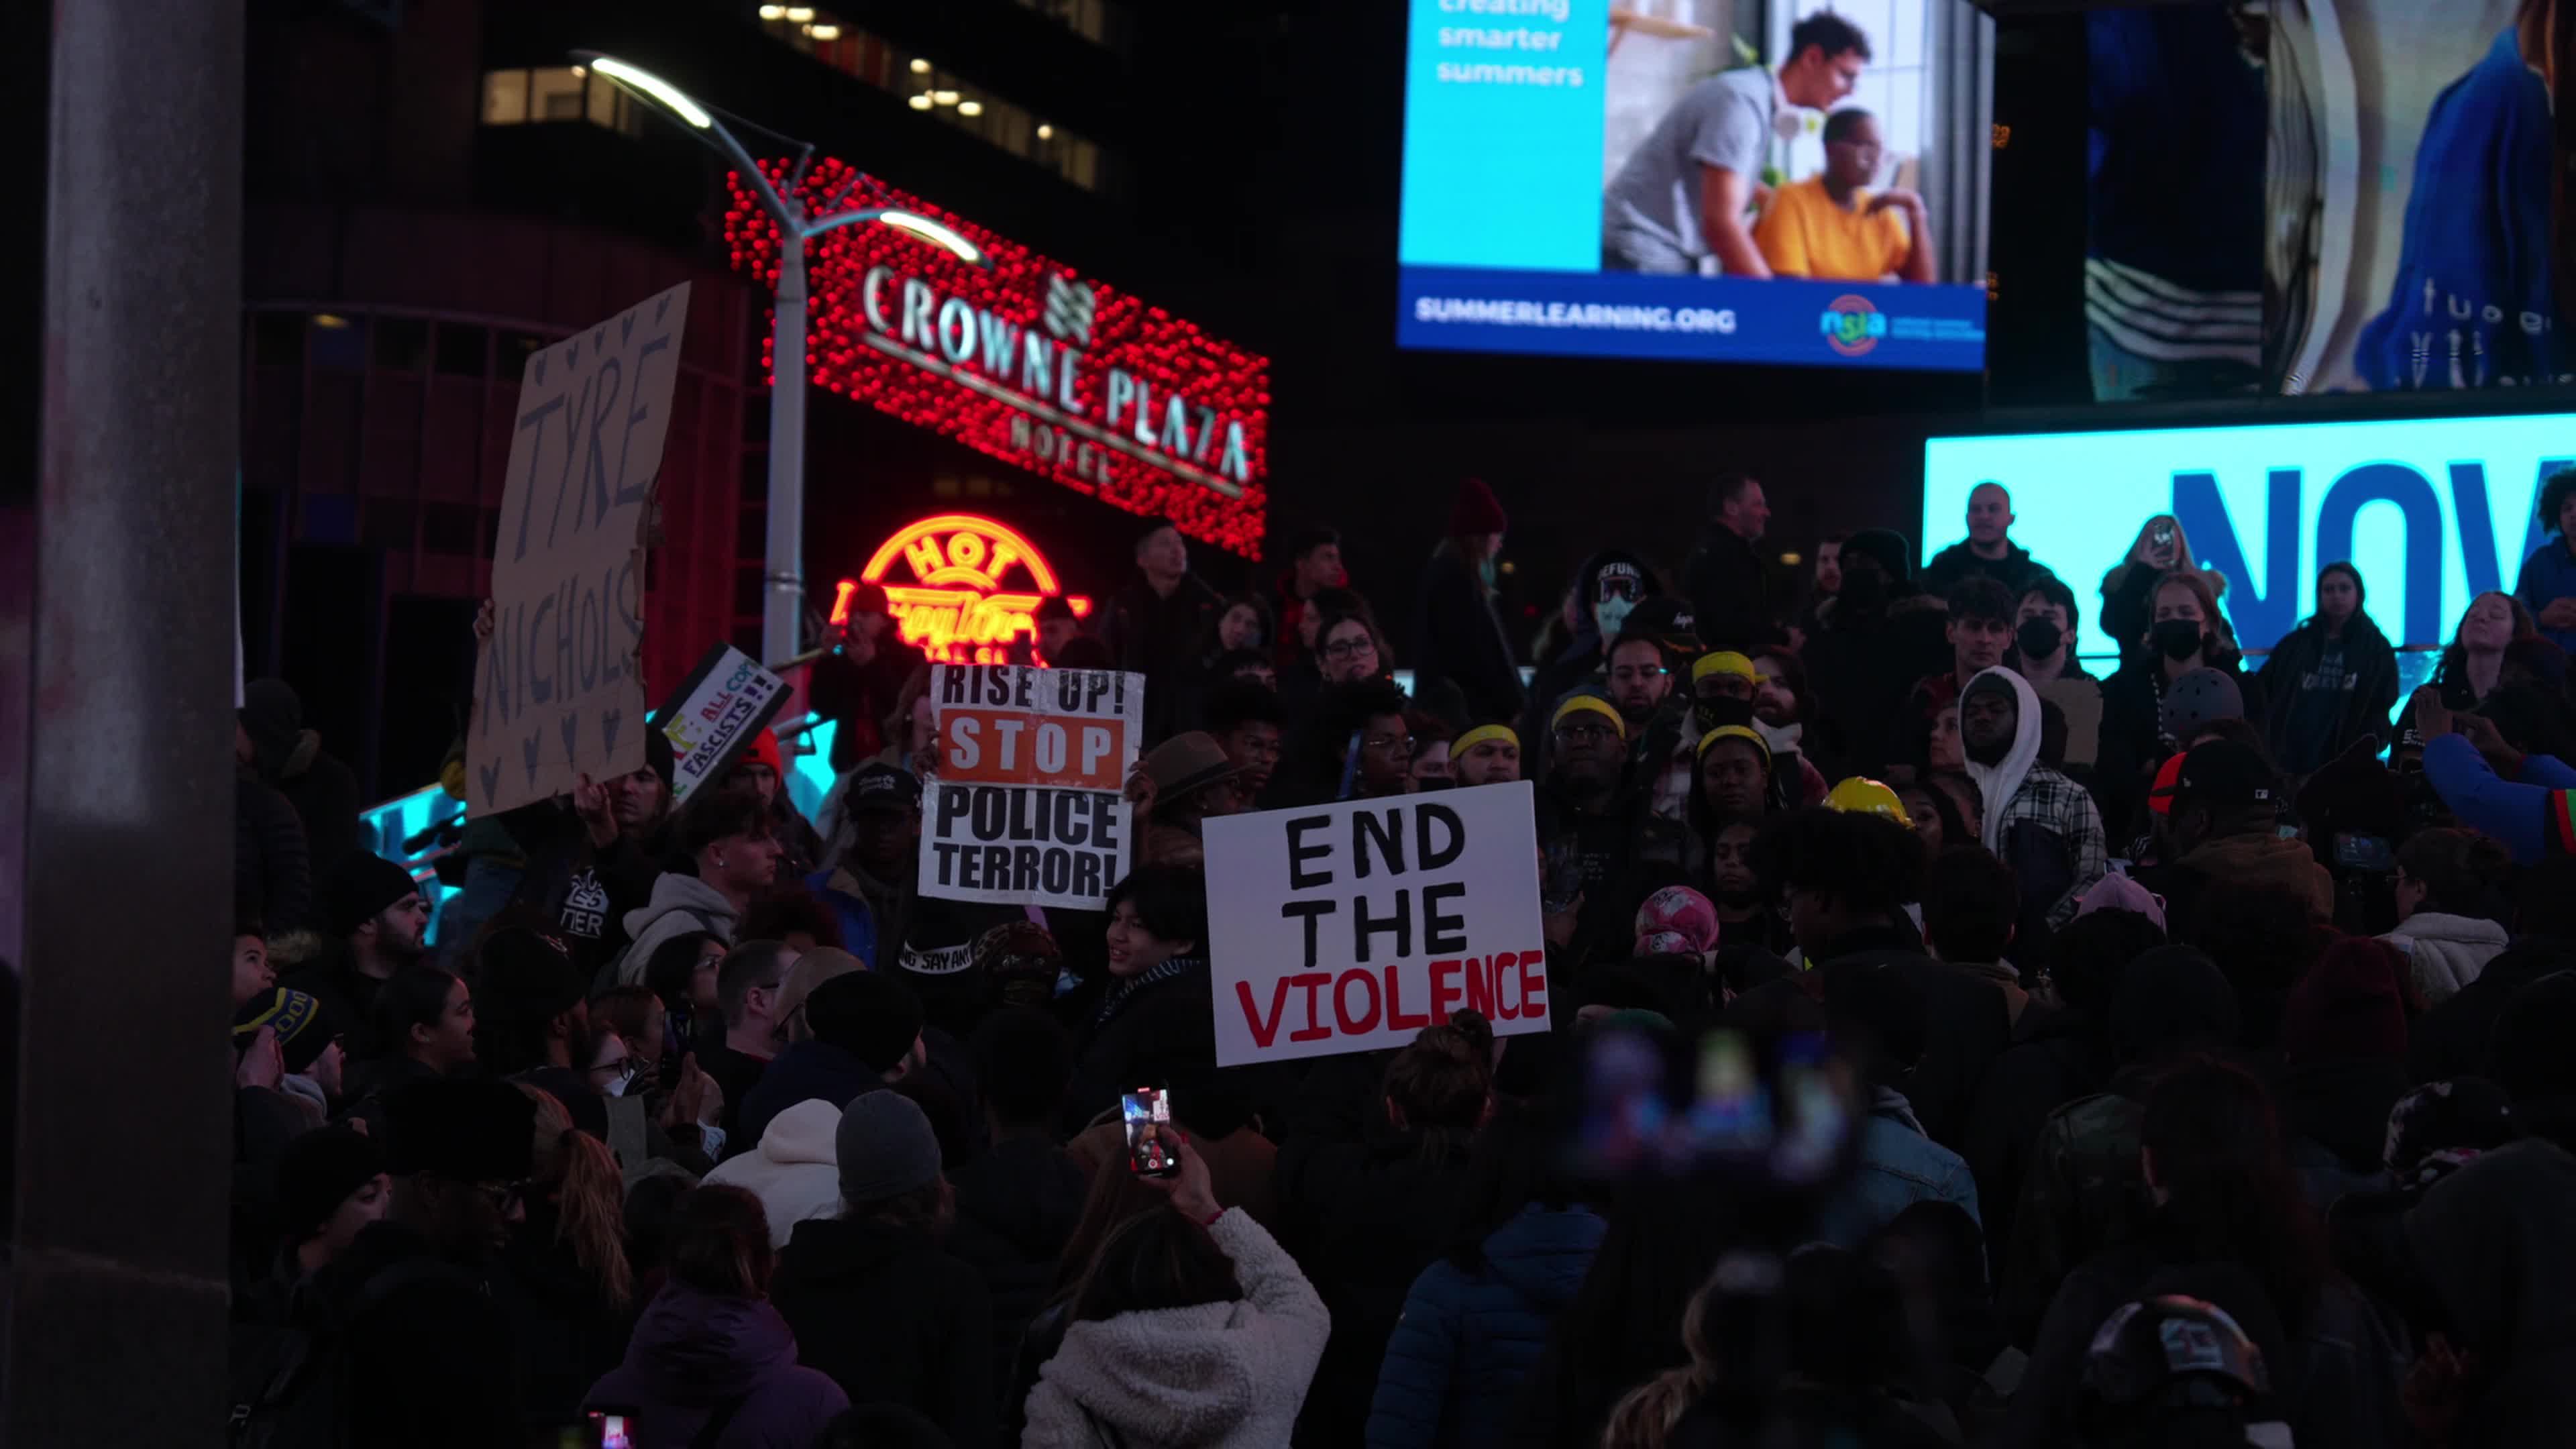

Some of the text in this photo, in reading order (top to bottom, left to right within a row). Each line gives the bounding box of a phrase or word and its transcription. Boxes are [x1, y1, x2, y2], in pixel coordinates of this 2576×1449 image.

[1440, 27, 1562, 50] smarter
[1438, 62, 1583, 87] summers
[1415, 297, 1736, 333] SUMMERLEARNING.ORG
[863, 266, 1250, 482] CROWNE PLAZA
[515, 333, 670, 562] TYRE
[1010, 415, 1113, 484] HOTEL
[904, 531, 1018, 580] HOT
[482, 557, 641, 737] NICHOLS
[701, 690, 733, 724] ALL
[943, 664, 1124, 714] RISE UP!
[950, 716, 1112, 775] STOP
[936, 785, 1119, 849] POLICE
[1285, 802, 1466, 891] END
[932, 841, 1117, 898] TERROR!
[1281, 881, 1467, 967] THE
[1235, 950, 1546, 1049] VIOLENCE
